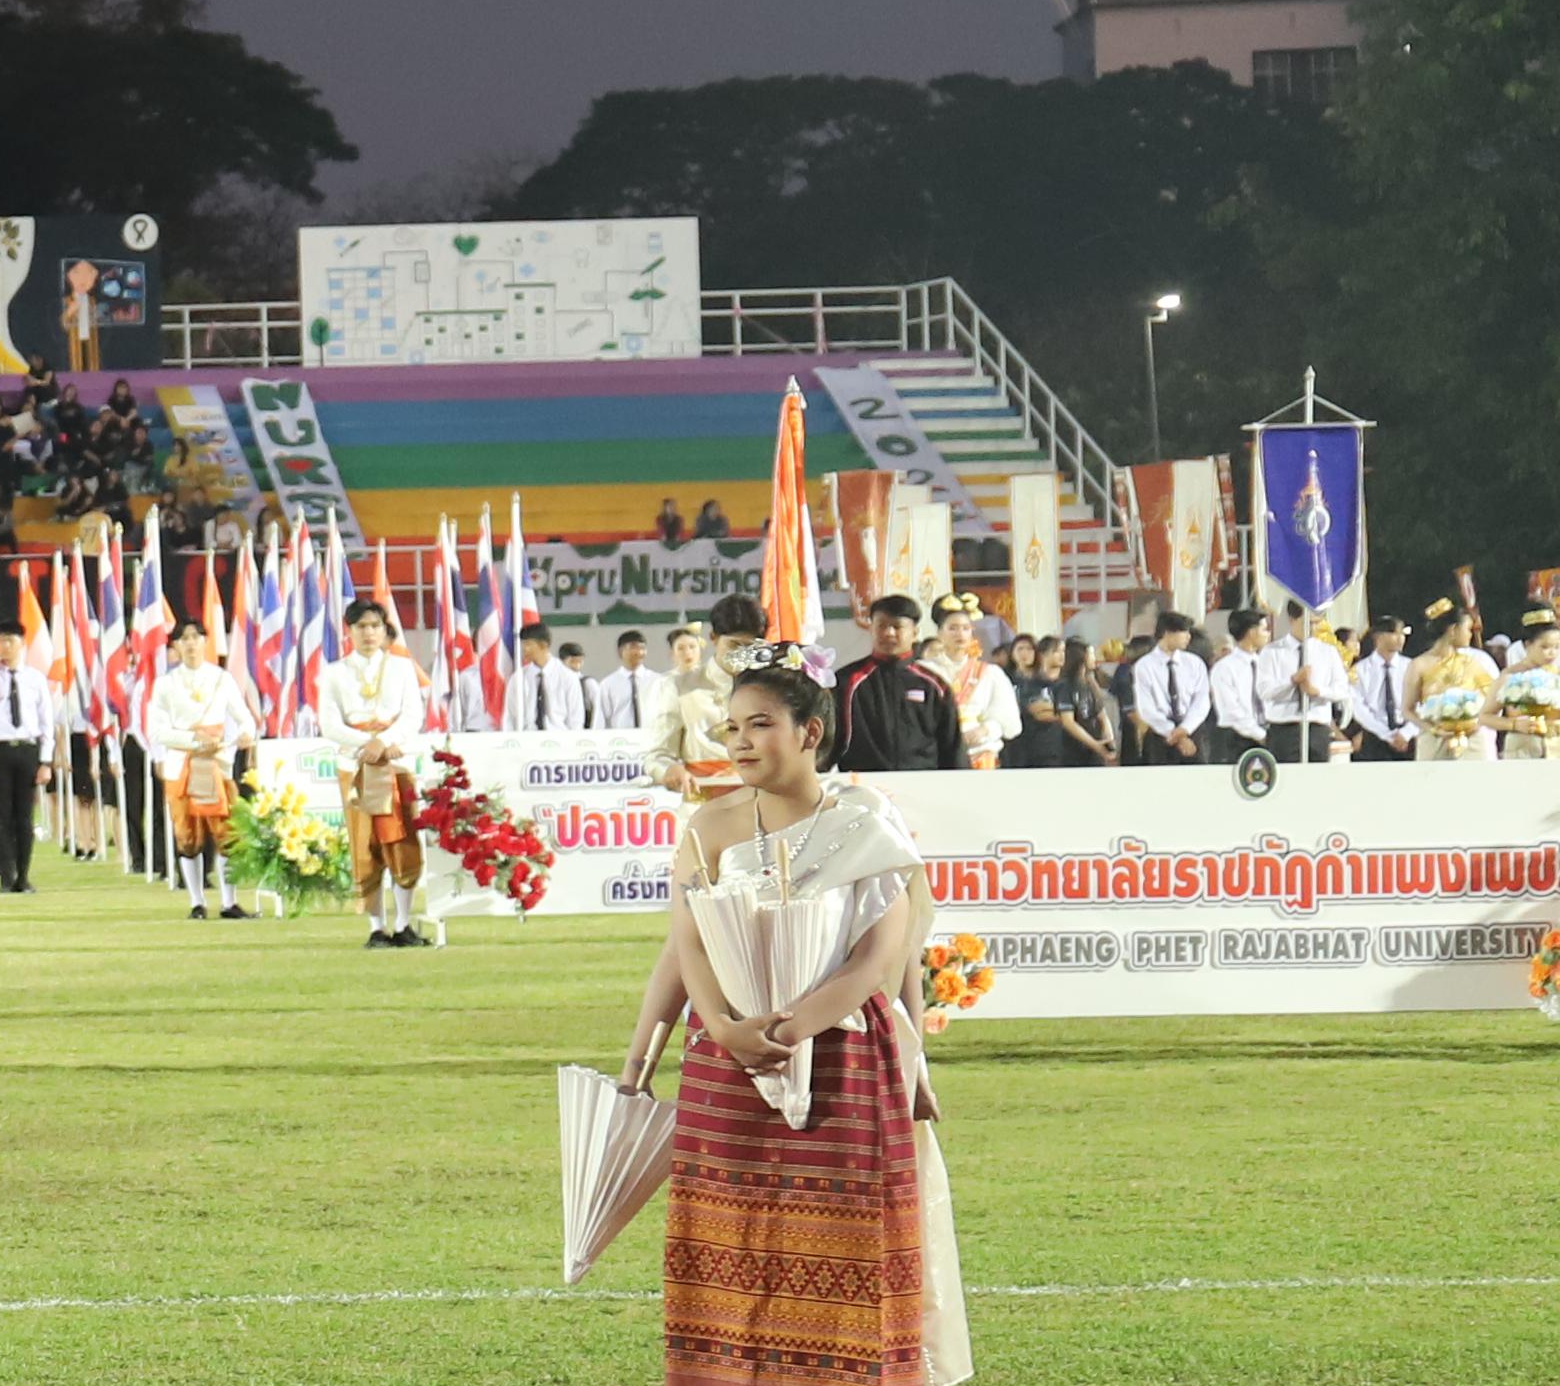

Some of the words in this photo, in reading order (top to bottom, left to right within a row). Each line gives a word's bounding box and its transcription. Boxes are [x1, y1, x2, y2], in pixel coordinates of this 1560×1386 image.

[926, 836, 1560, 909] มหาวิทยาลัยราชภัฏกำแพงเพช
[982, 935, 1118, 964] MPHAENG
[1136, 934, 1203, 963] PHET
[1223, 930, 1366, 960] RAJABHAT
[1384, 926, 1548, 958] UNIVERSITY
